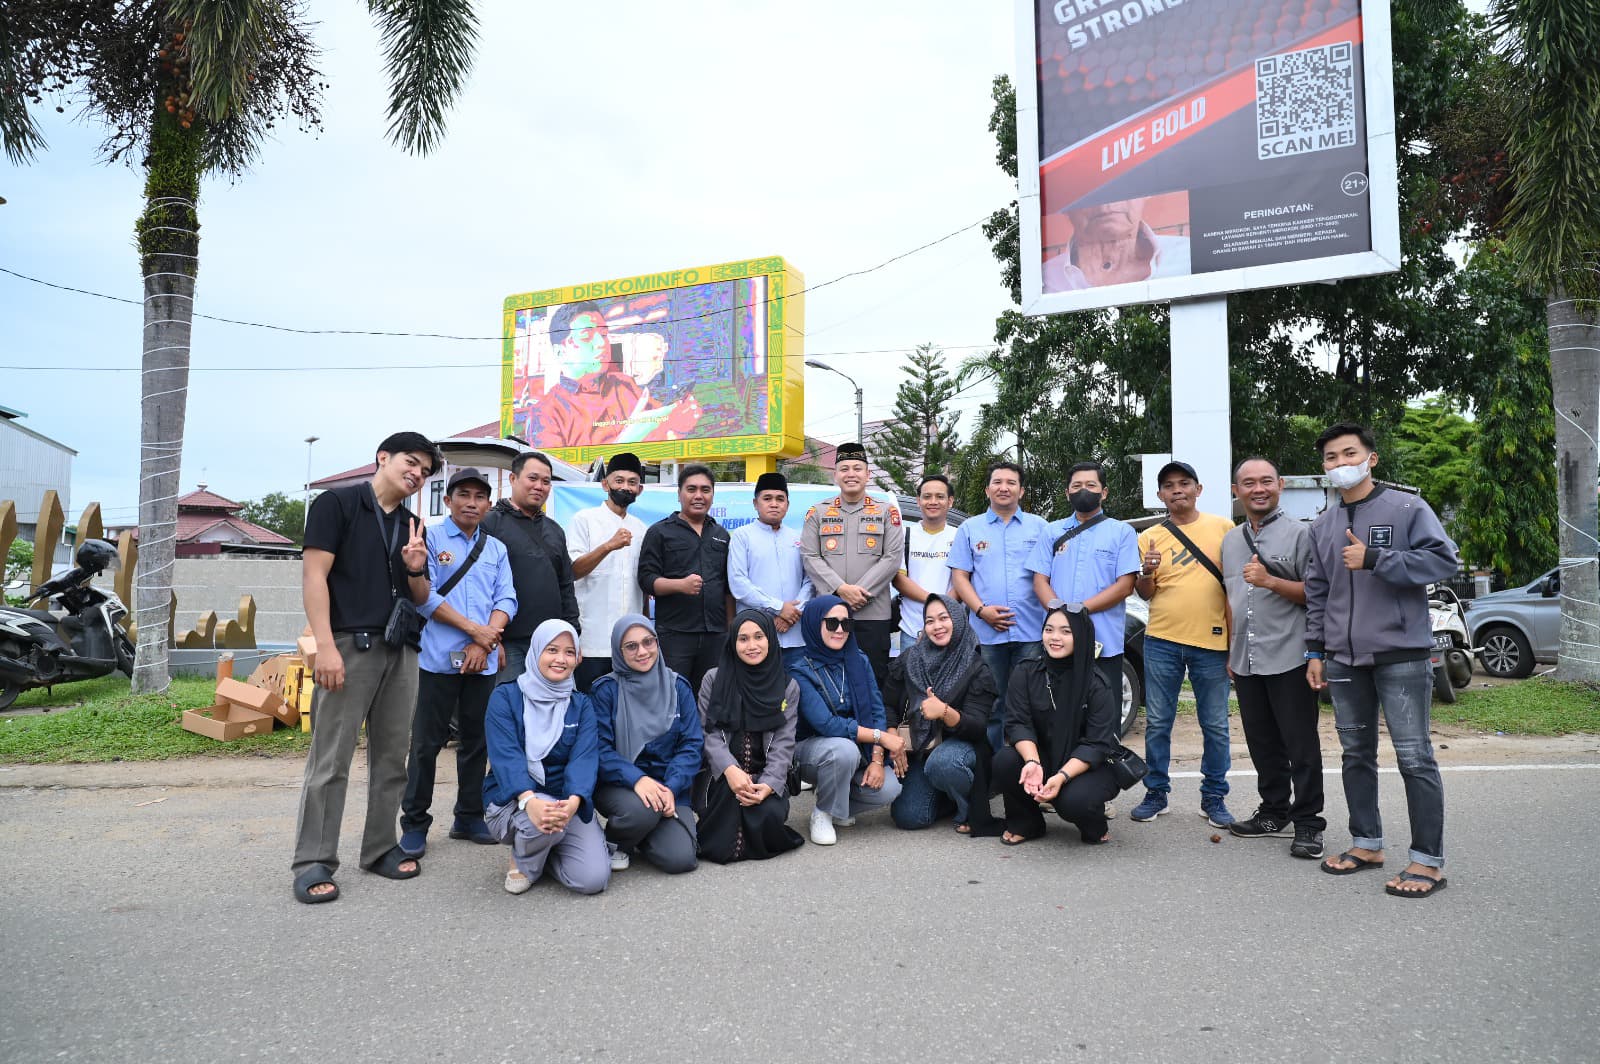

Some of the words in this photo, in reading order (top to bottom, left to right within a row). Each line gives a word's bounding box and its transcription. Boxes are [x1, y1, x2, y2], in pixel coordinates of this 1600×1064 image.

[1101, 126, 1146, 172] LIVE
[1151, 96, 1206, 145] BOLD
[1260, 136, 1313, 158] SCAN
[1318, 130, 1354, 149] ME!
[1344, 179, 1366, 190] 21+
[1244, 203, 1314, 220] PERINGATAN:
[572, 269, 700, 300] DISKOMINFO
